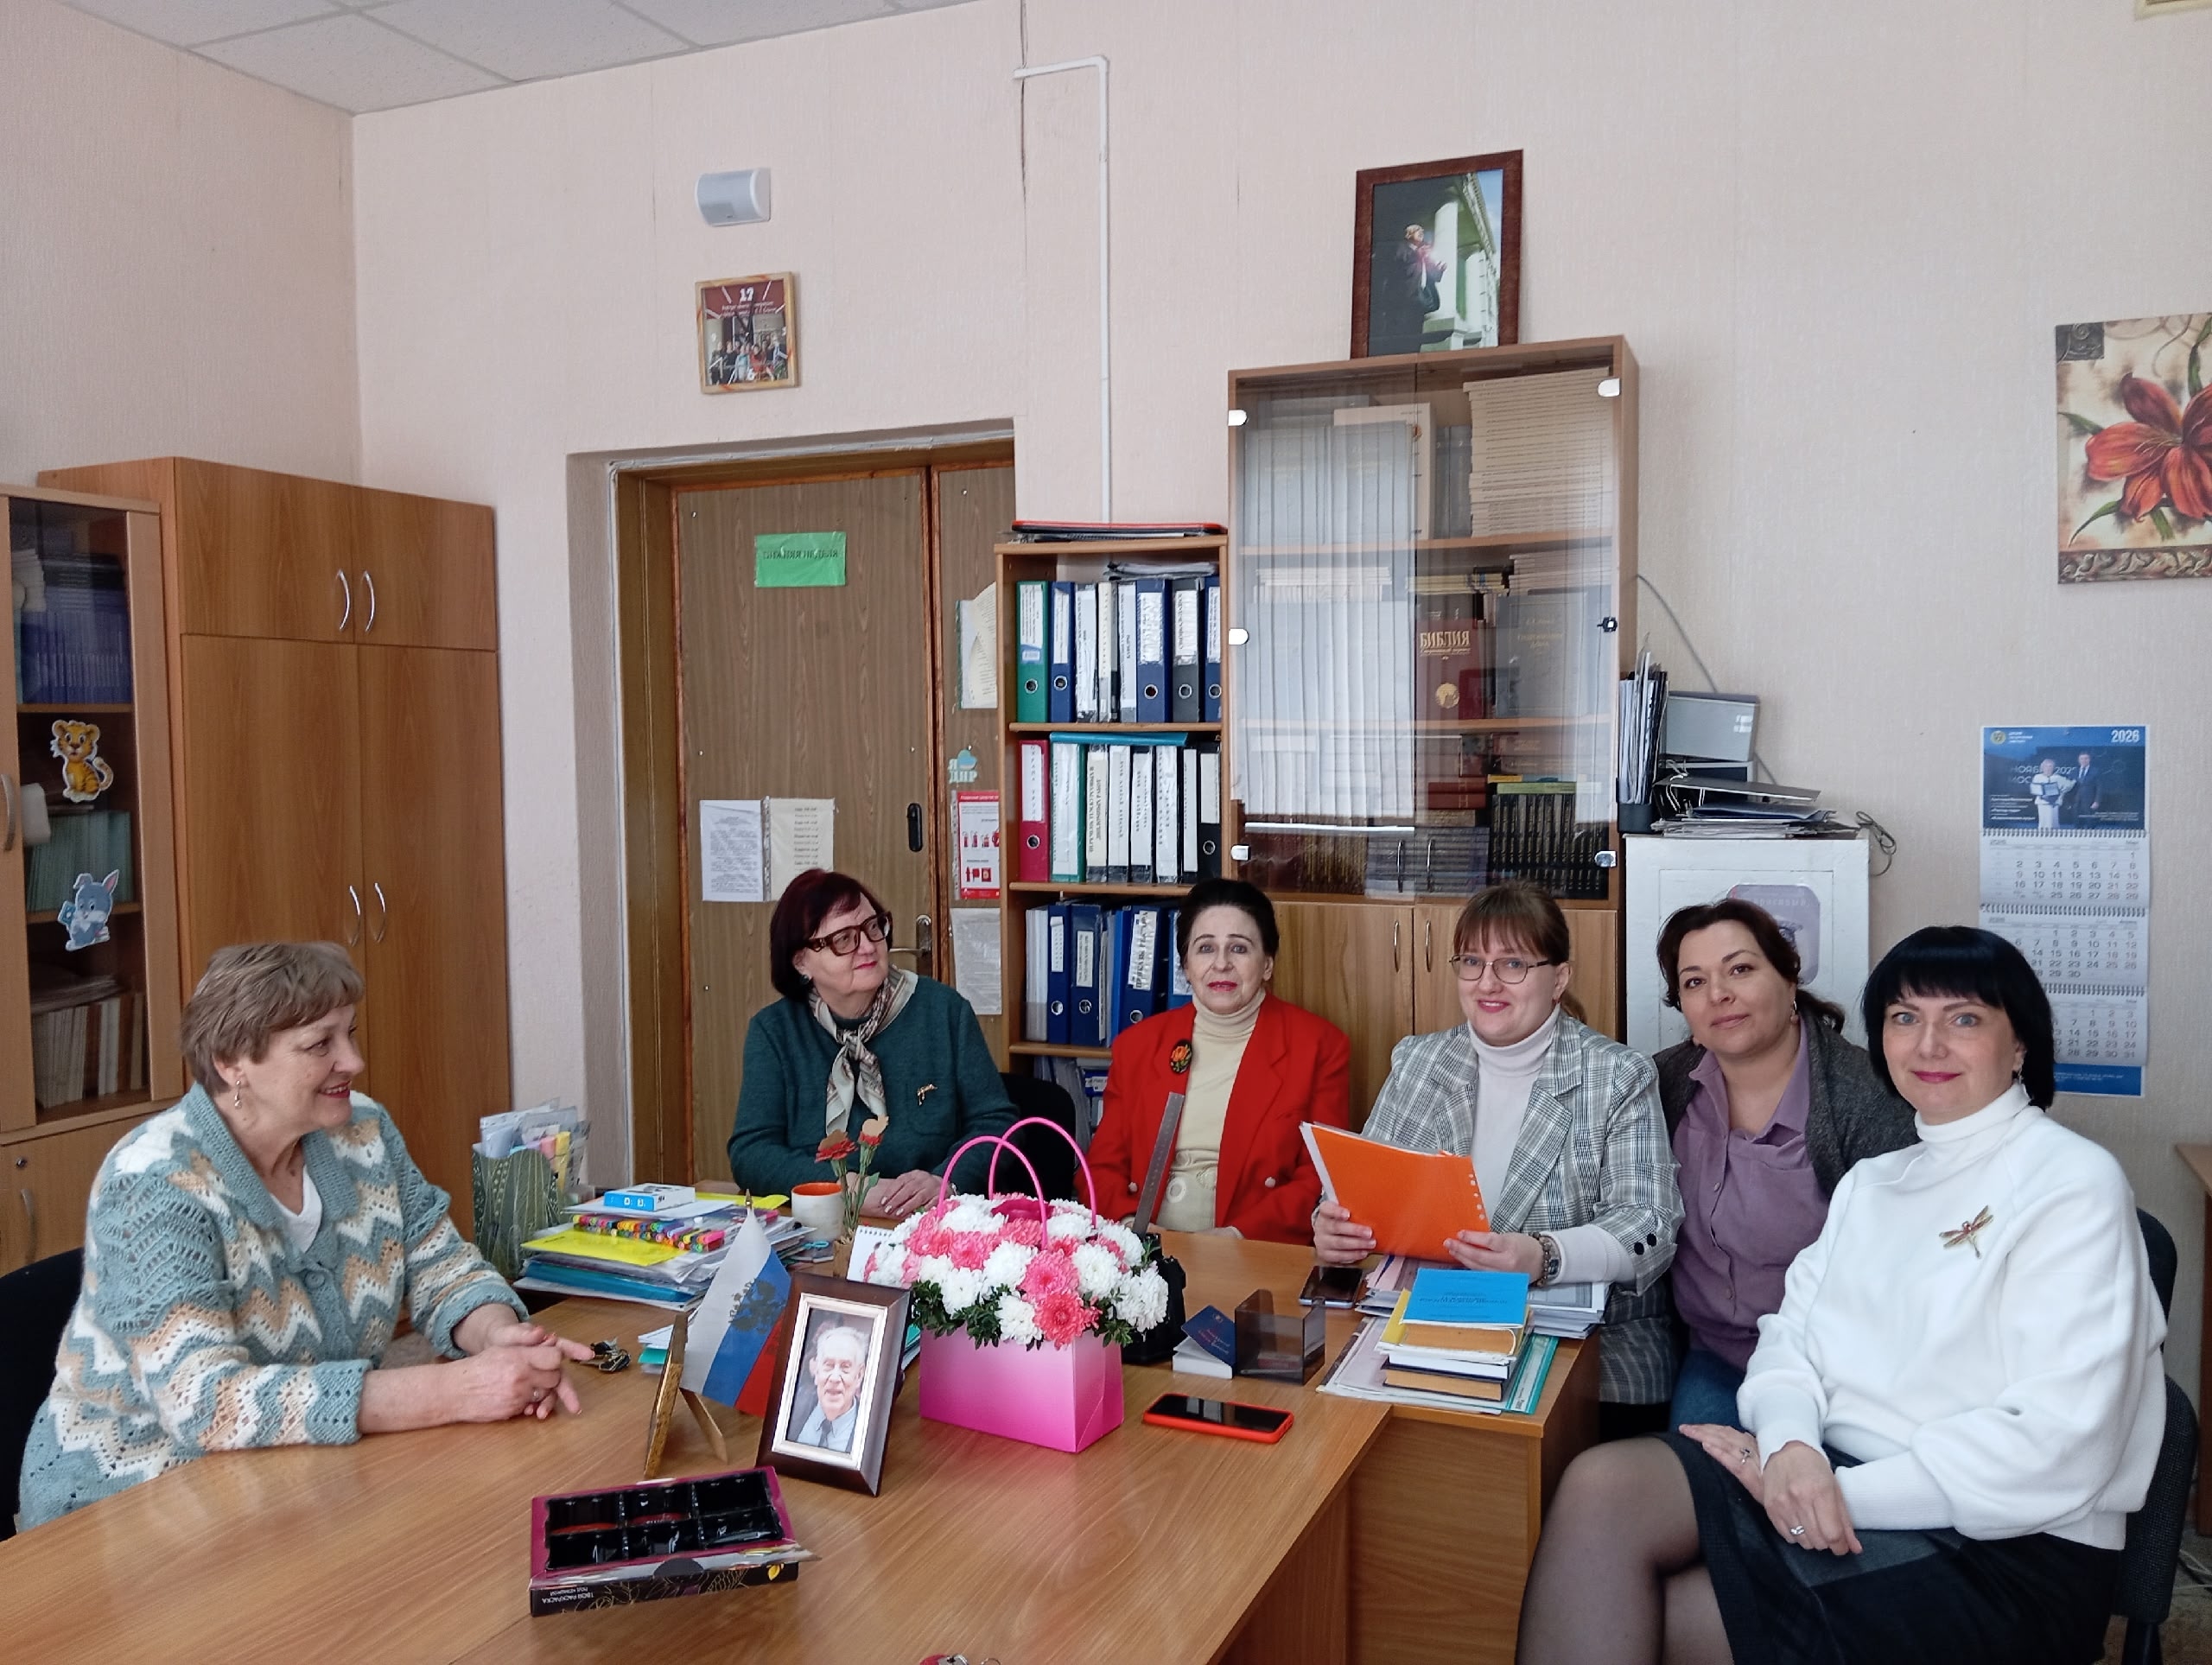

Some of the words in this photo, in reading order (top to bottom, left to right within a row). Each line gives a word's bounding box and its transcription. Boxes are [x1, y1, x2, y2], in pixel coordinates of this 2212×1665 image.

[740, 287, 754, 301] 12
[747, 369, 754, 380] 6
[1420, 630, 1470, 648] БИБЛИЯ
[2111, 729, 2139, 742] 2026
